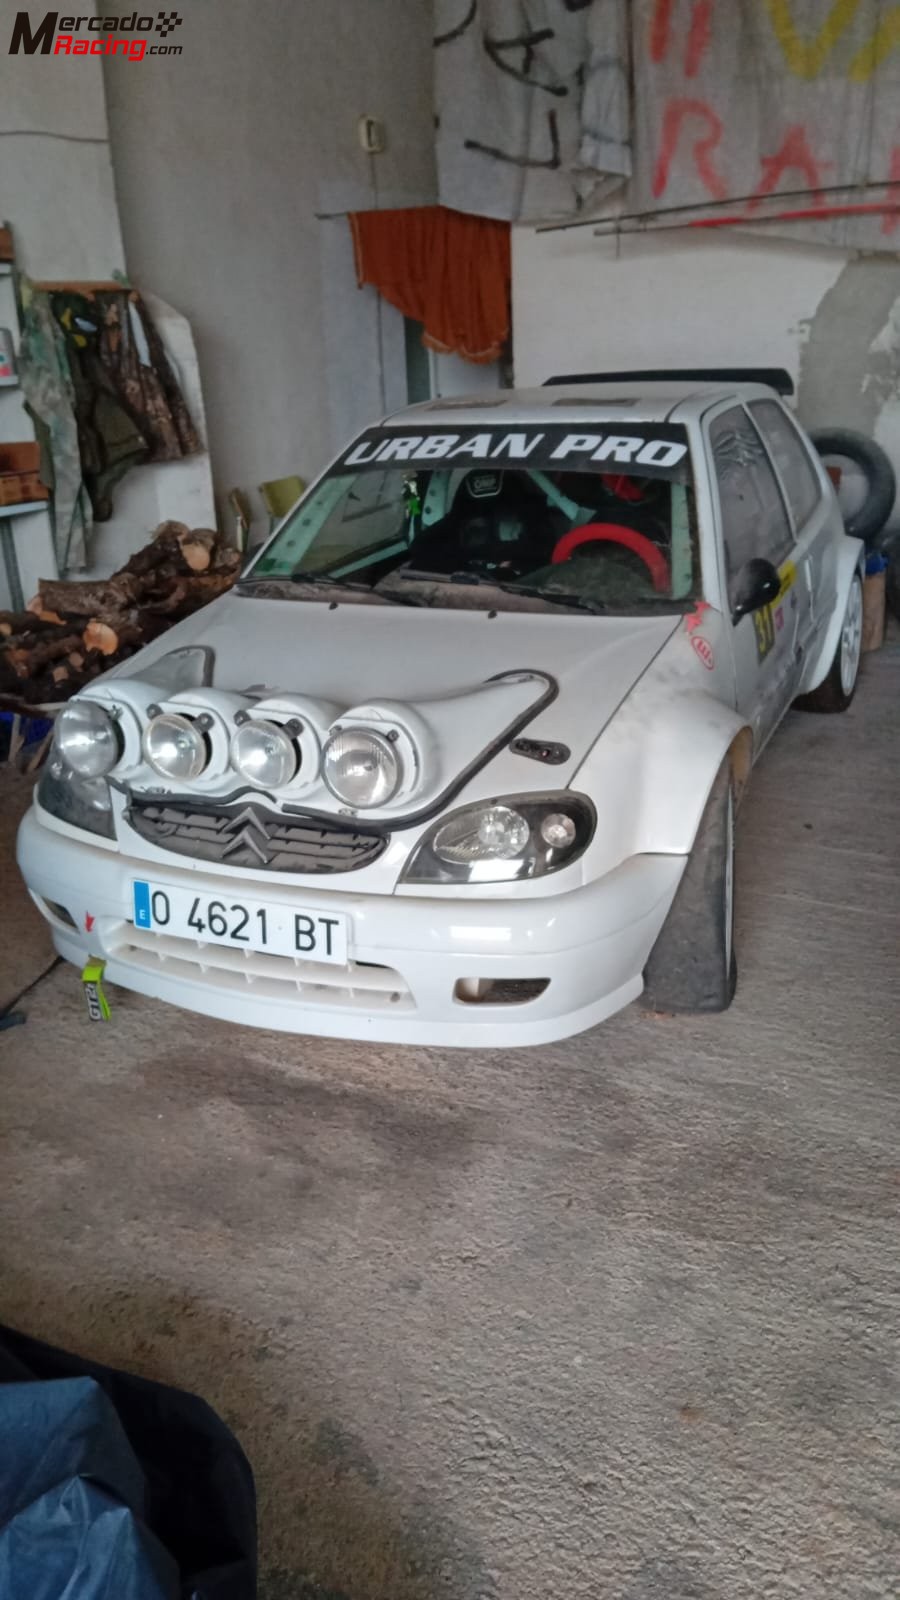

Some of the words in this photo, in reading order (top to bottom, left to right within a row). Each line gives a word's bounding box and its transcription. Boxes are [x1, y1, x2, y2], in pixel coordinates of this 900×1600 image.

[344, 433, 545, 466] URBAN
[550, 433, 688, 468] PRO
[187, 897, 268, 945] 4621
[294, 913, 340, 956] BT
